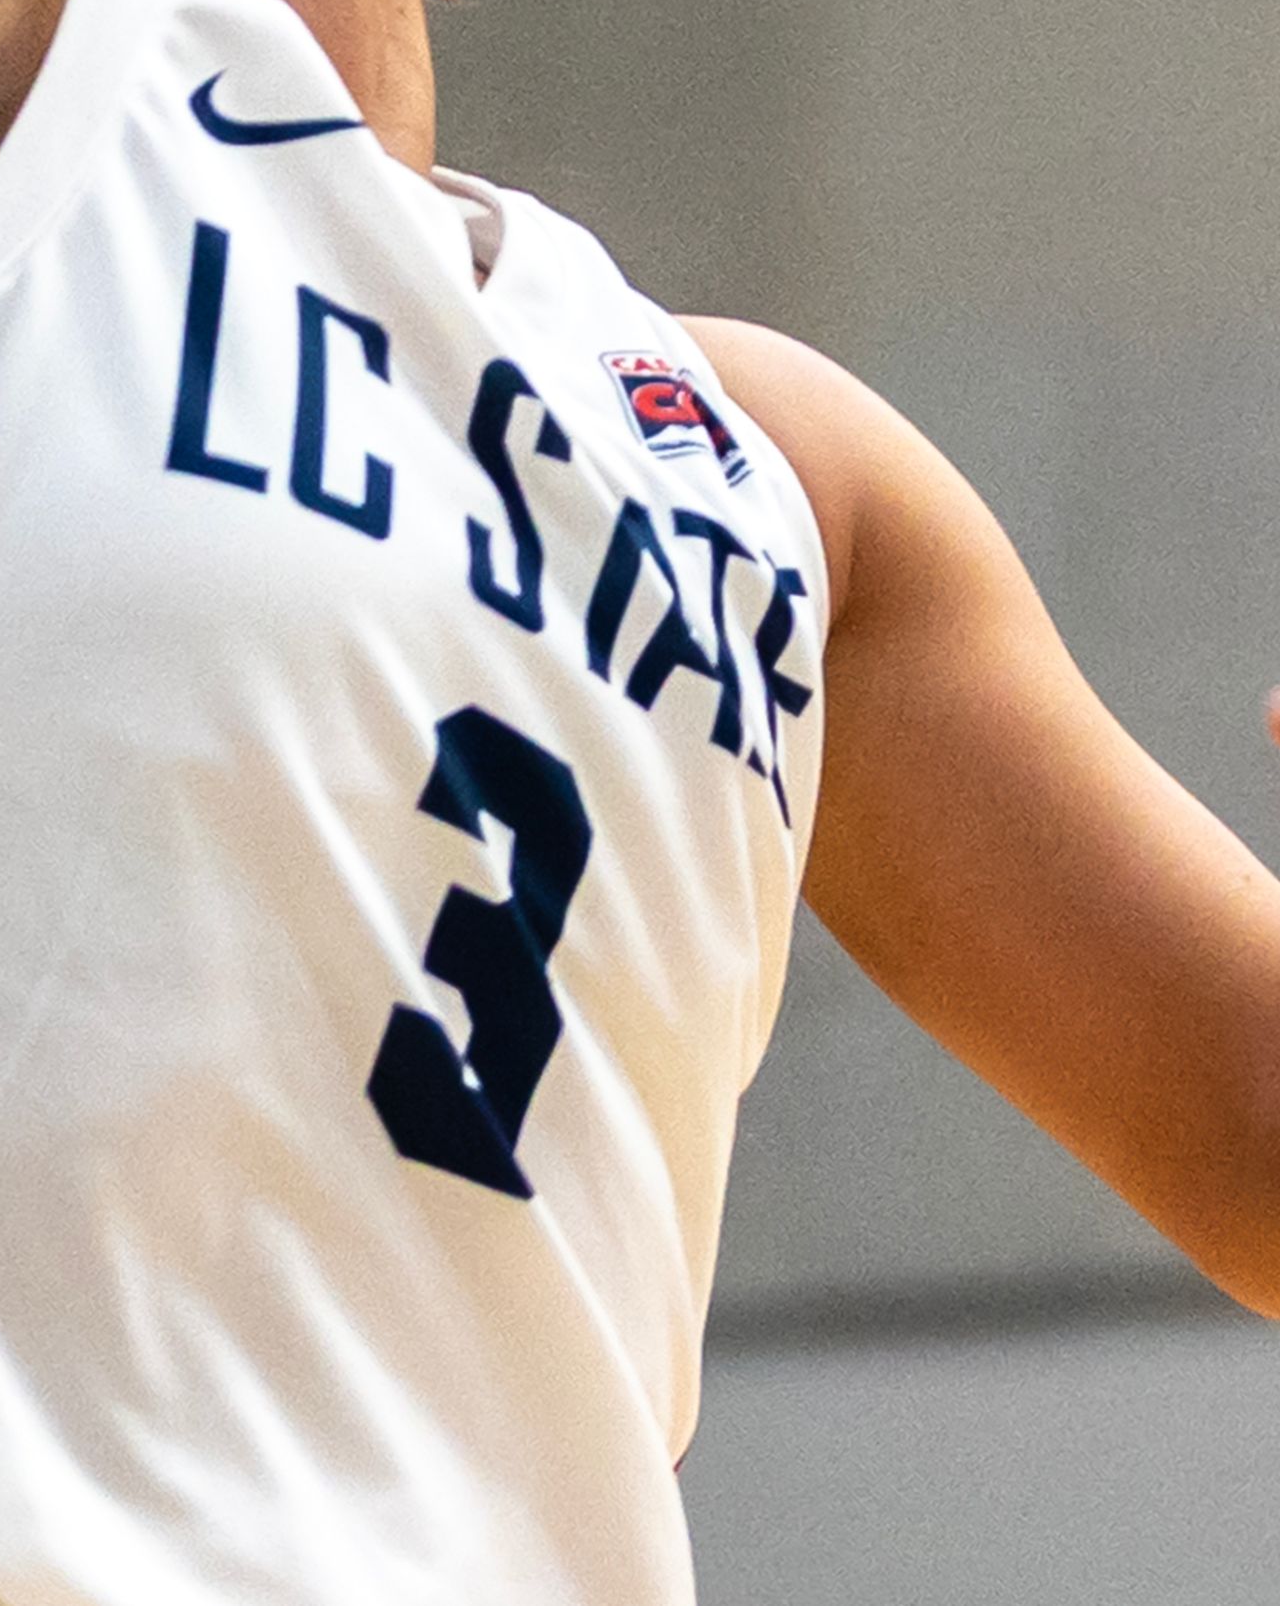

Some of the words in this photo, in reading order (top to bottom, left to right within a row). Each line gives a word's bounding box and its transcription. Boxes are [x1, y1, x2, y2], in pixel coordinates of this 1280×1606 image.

[164, 219, 396, 542] LC
[455, 356, 814, 832] STATE
[365, 702, 594, 1202] 3
